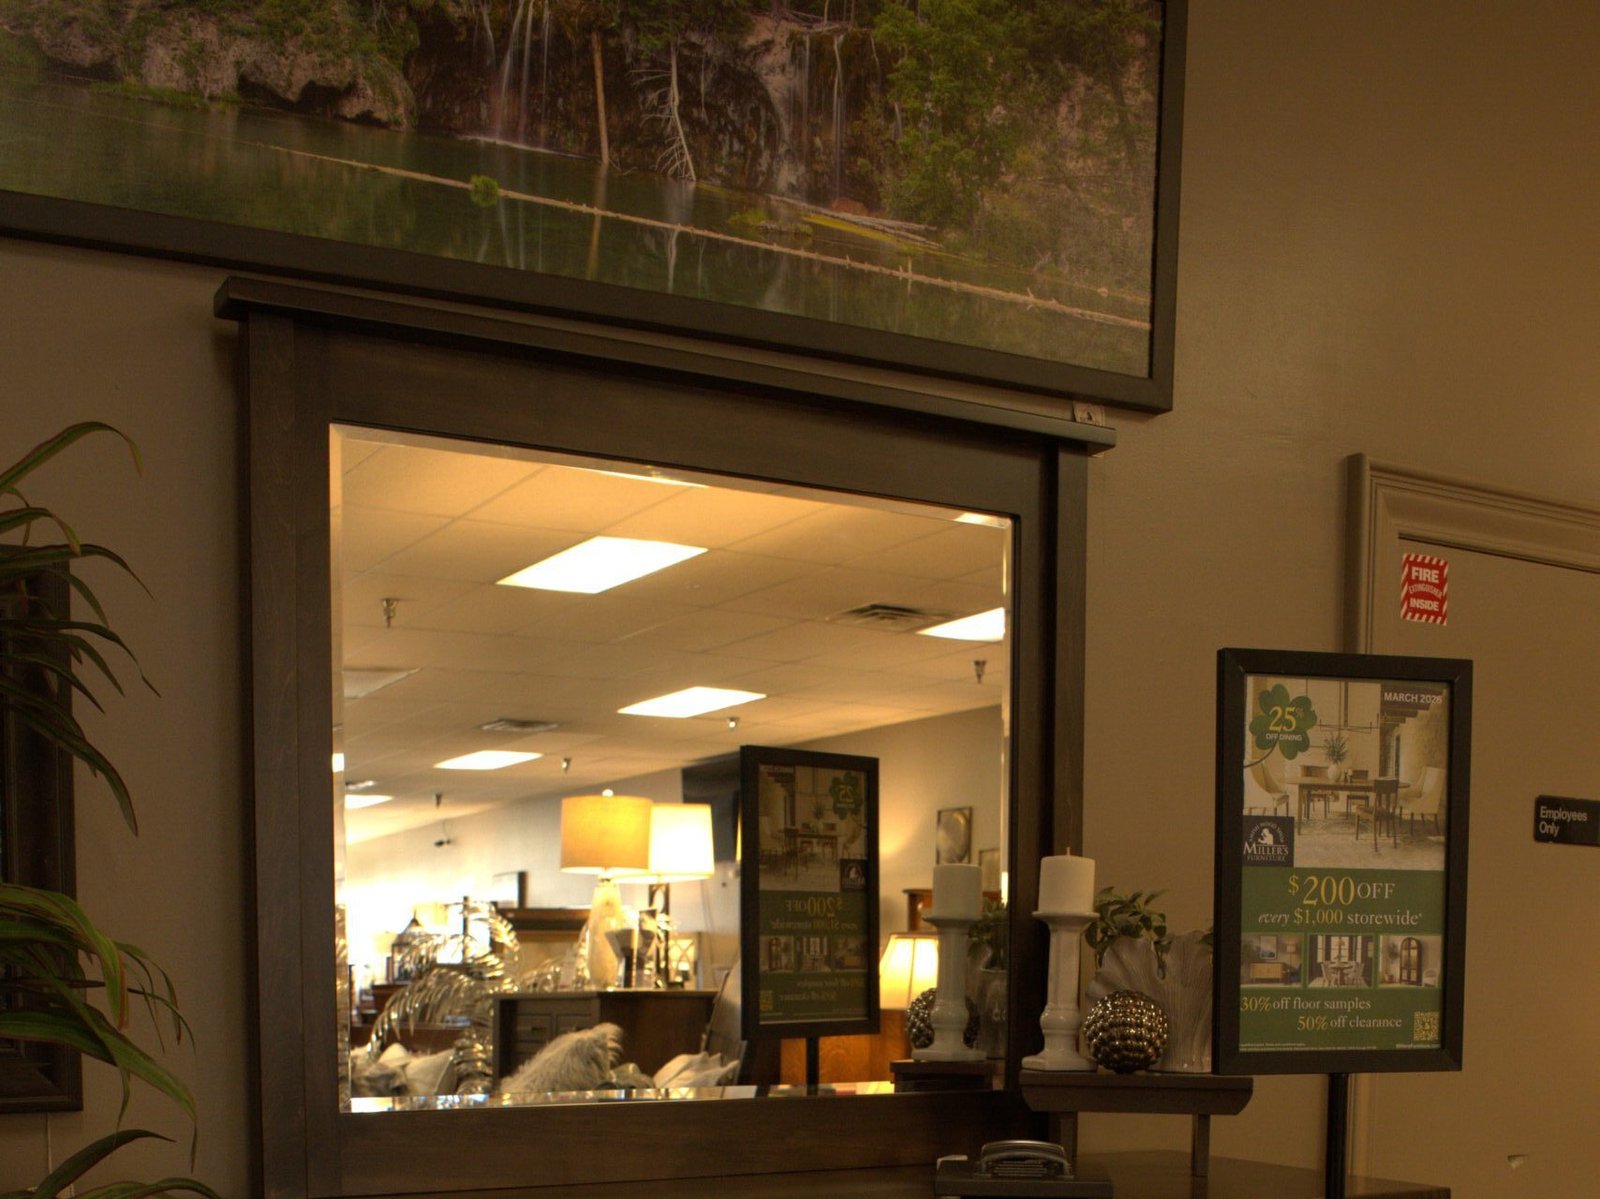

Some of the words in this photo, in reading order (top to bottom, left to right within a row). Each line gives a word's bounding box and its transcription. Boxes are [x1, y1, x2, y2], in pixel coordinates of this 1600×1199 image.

[1411, 566, 1440, 583] FIRE
[1410, 597, 1440, 611] INSIDE
[1384, 692, 1418, 703] MARCH
[1539, 805, 1588, 822] Employees
[1538, 821, 1560, 838] Only
[1288, 875, 1355, 906] $200
[1357, 883, 1396, 899] OFF
[1258, 912, 1290, 927] every
[1293, 908, 1343, 925] $1,000
[1240, 996, 1272, 1012] 30%
[1273, 997, 1292, 1009] off
[1293, 997, 1320, 1009] floor
[1323, 997, 1372, 1012] samples
[1297, 1015, 1328, 1031] 50%
[1330, 1016, 1348, 1027] off
[1349, 1015, 1402, 1028] clearance
